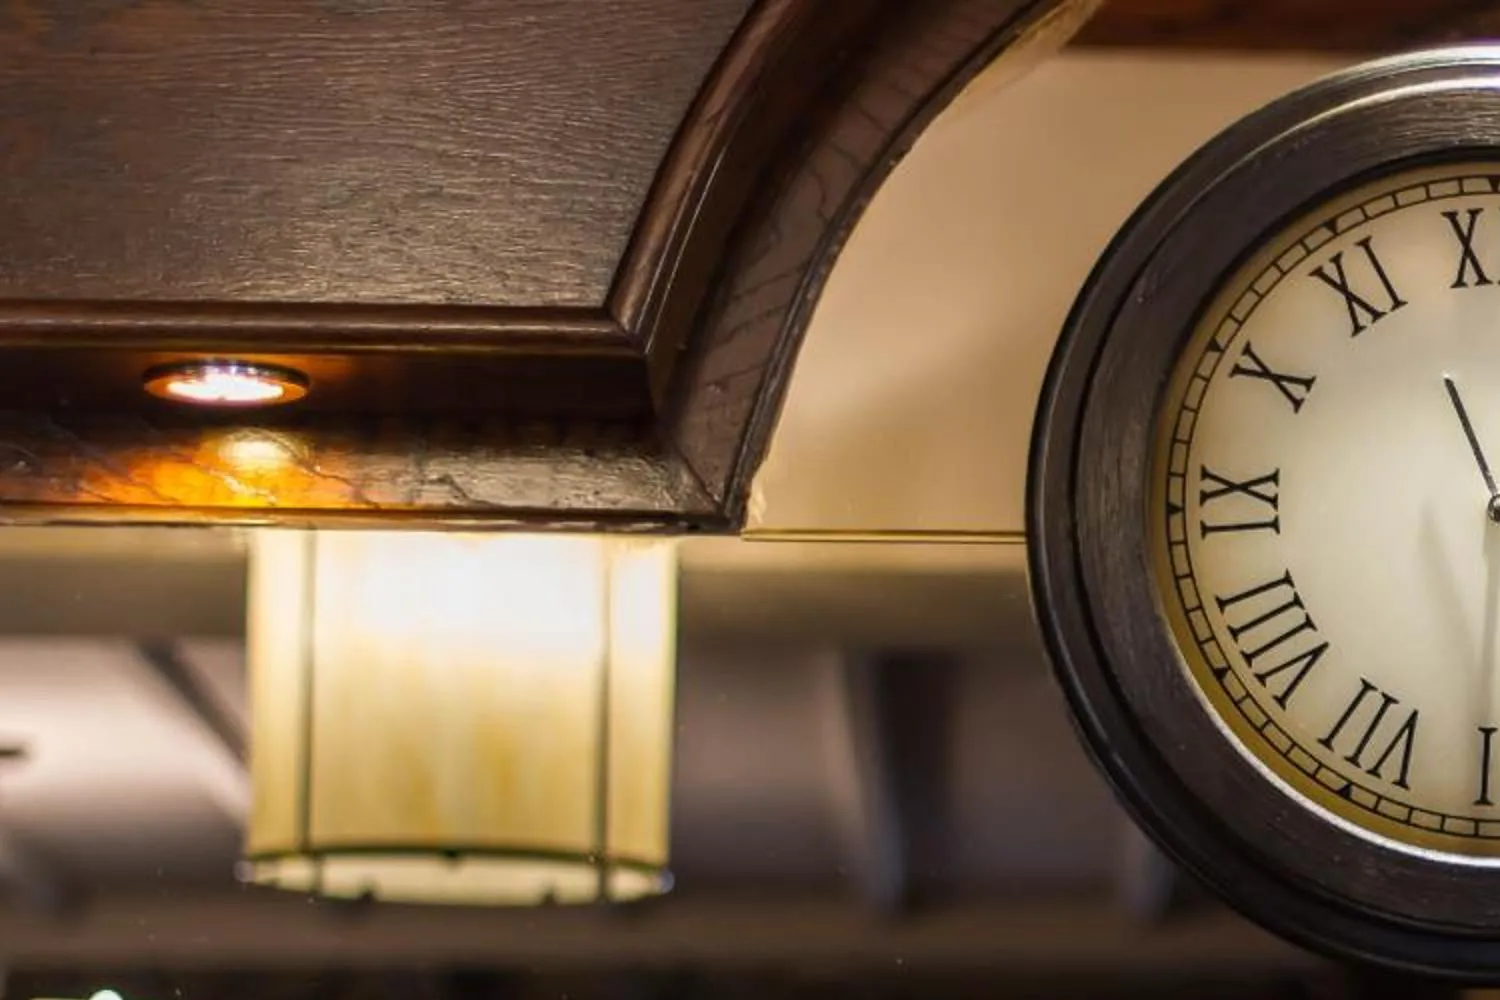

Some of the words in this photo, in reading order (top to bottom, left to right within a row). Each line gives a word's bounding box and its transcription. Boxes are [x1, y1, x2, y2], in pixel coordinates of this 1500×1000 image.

[1311, 237, 1408, 336] XI
[1230, 342, 1317, 413] X
[1200, 464, 1280, 538] IX
[1215, 570, 1331, 710] VIII
[1318, 678, 1421, 791] VII
